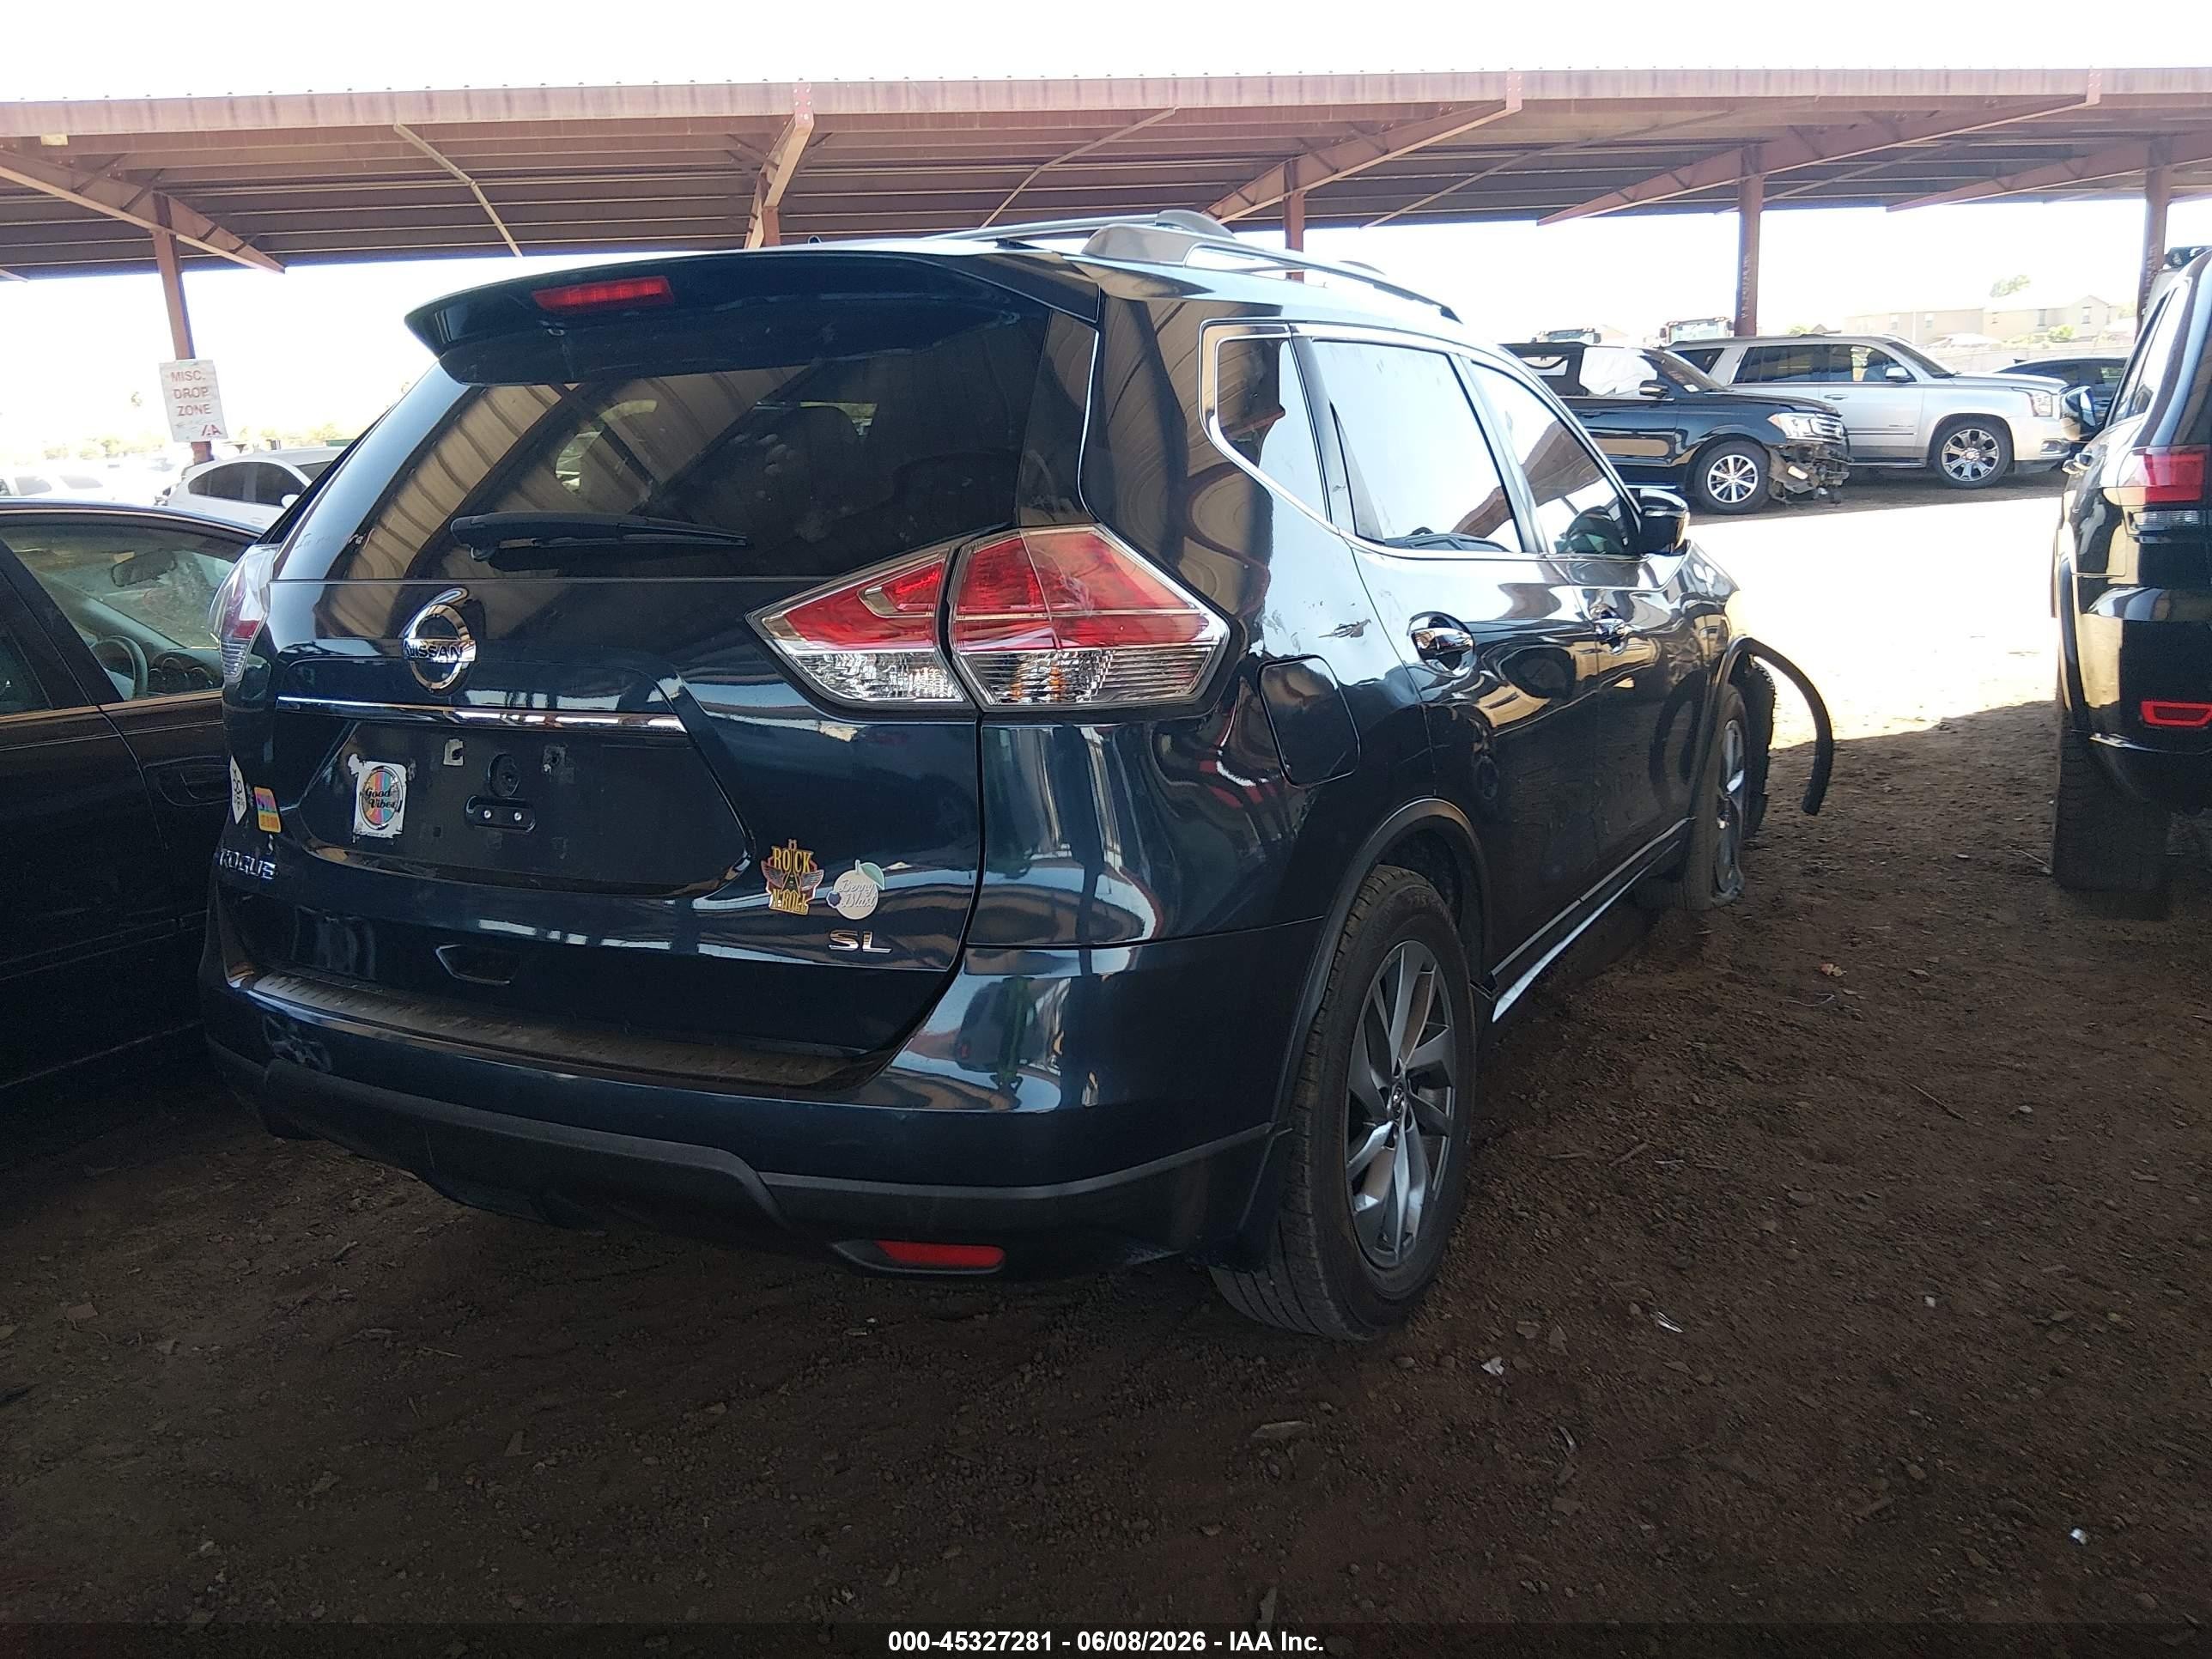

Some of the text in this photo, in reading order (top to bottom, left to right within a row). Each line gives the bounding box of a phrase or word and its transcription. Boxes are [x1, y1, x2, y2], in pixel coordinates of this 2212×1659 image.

[171, 370, 206, 382] MISC.
[173, 386, 209, 399] DROP
[177, 404, 212, 416] ZONE
[404, 641, 463, 659] NISSAN
[366, 786, 392, 799] Good
[368, 799, 395, 809] Vibes
[218, 848, 277, 880] ROGUE
[772, 847, 813, 873] ROCK
[829, 929, 893, 953] SL
